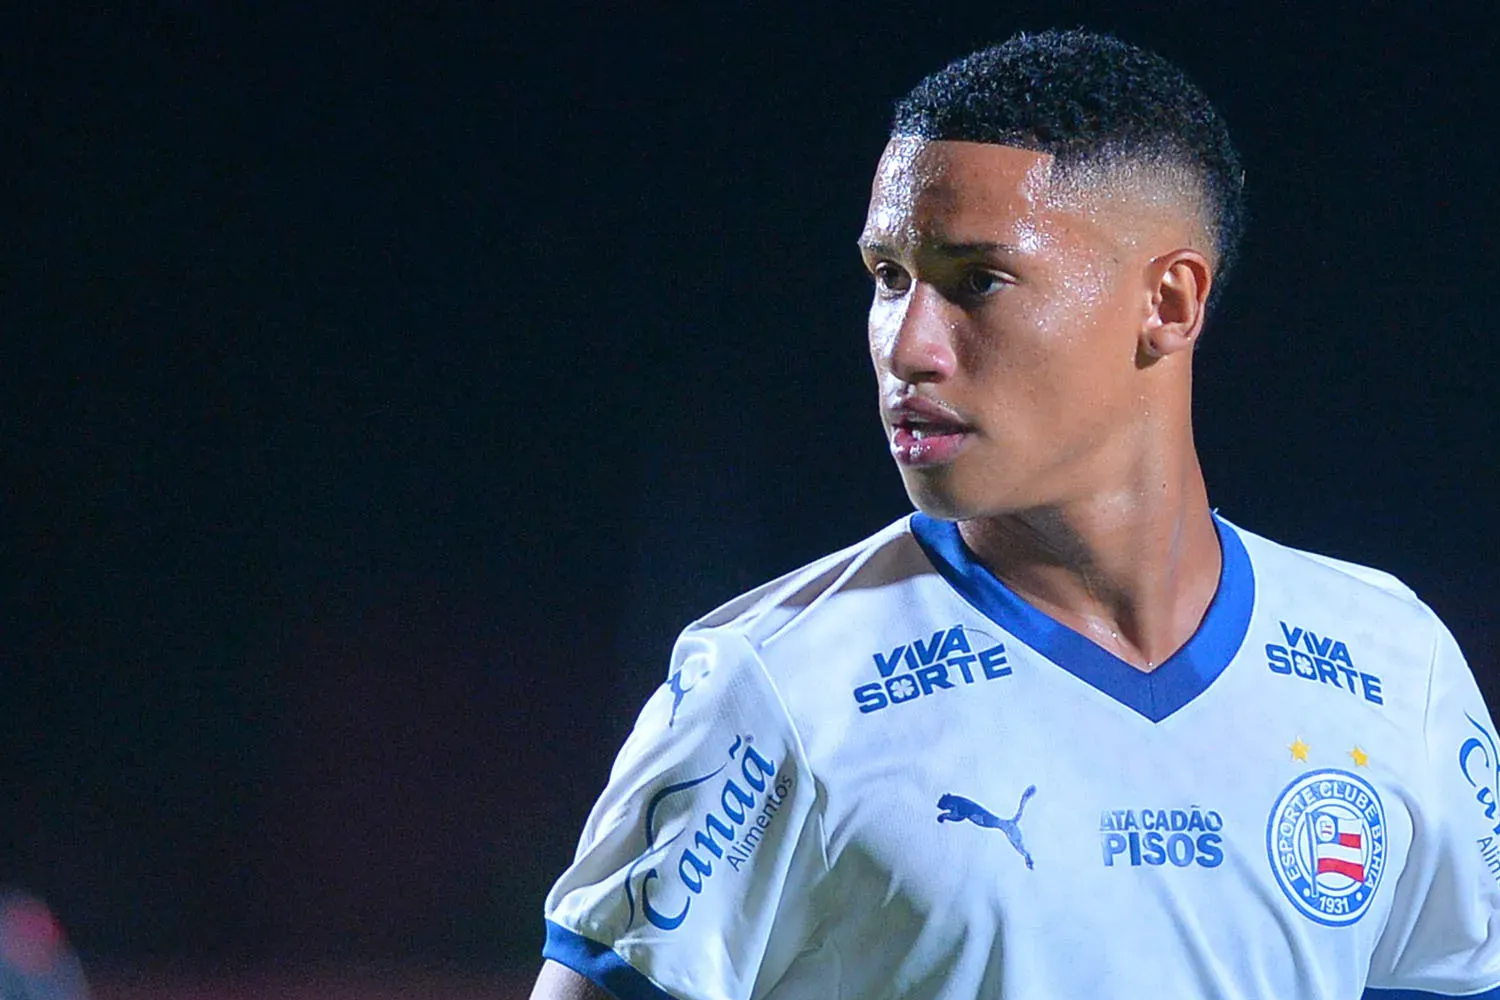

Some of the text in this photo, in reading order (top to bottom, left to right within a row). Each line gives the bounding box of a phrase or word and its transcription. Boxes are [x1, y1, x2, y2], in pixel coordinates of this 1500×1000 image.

[873, 624, 972, 678] VIVA
[1278, 620, 1354, 668] VIVA
[853, 643, 1013, 714] SORTE
[1264, 643, 1384, 706] SORTE
[726, 774, 793, 873] Alimentos
[1101, 832, 1225, 868] PISOS
[1279, 781, 1384, 890] ESPORTE CLUBE BAHIA
[1319, 897, 1351, 914] 1931
